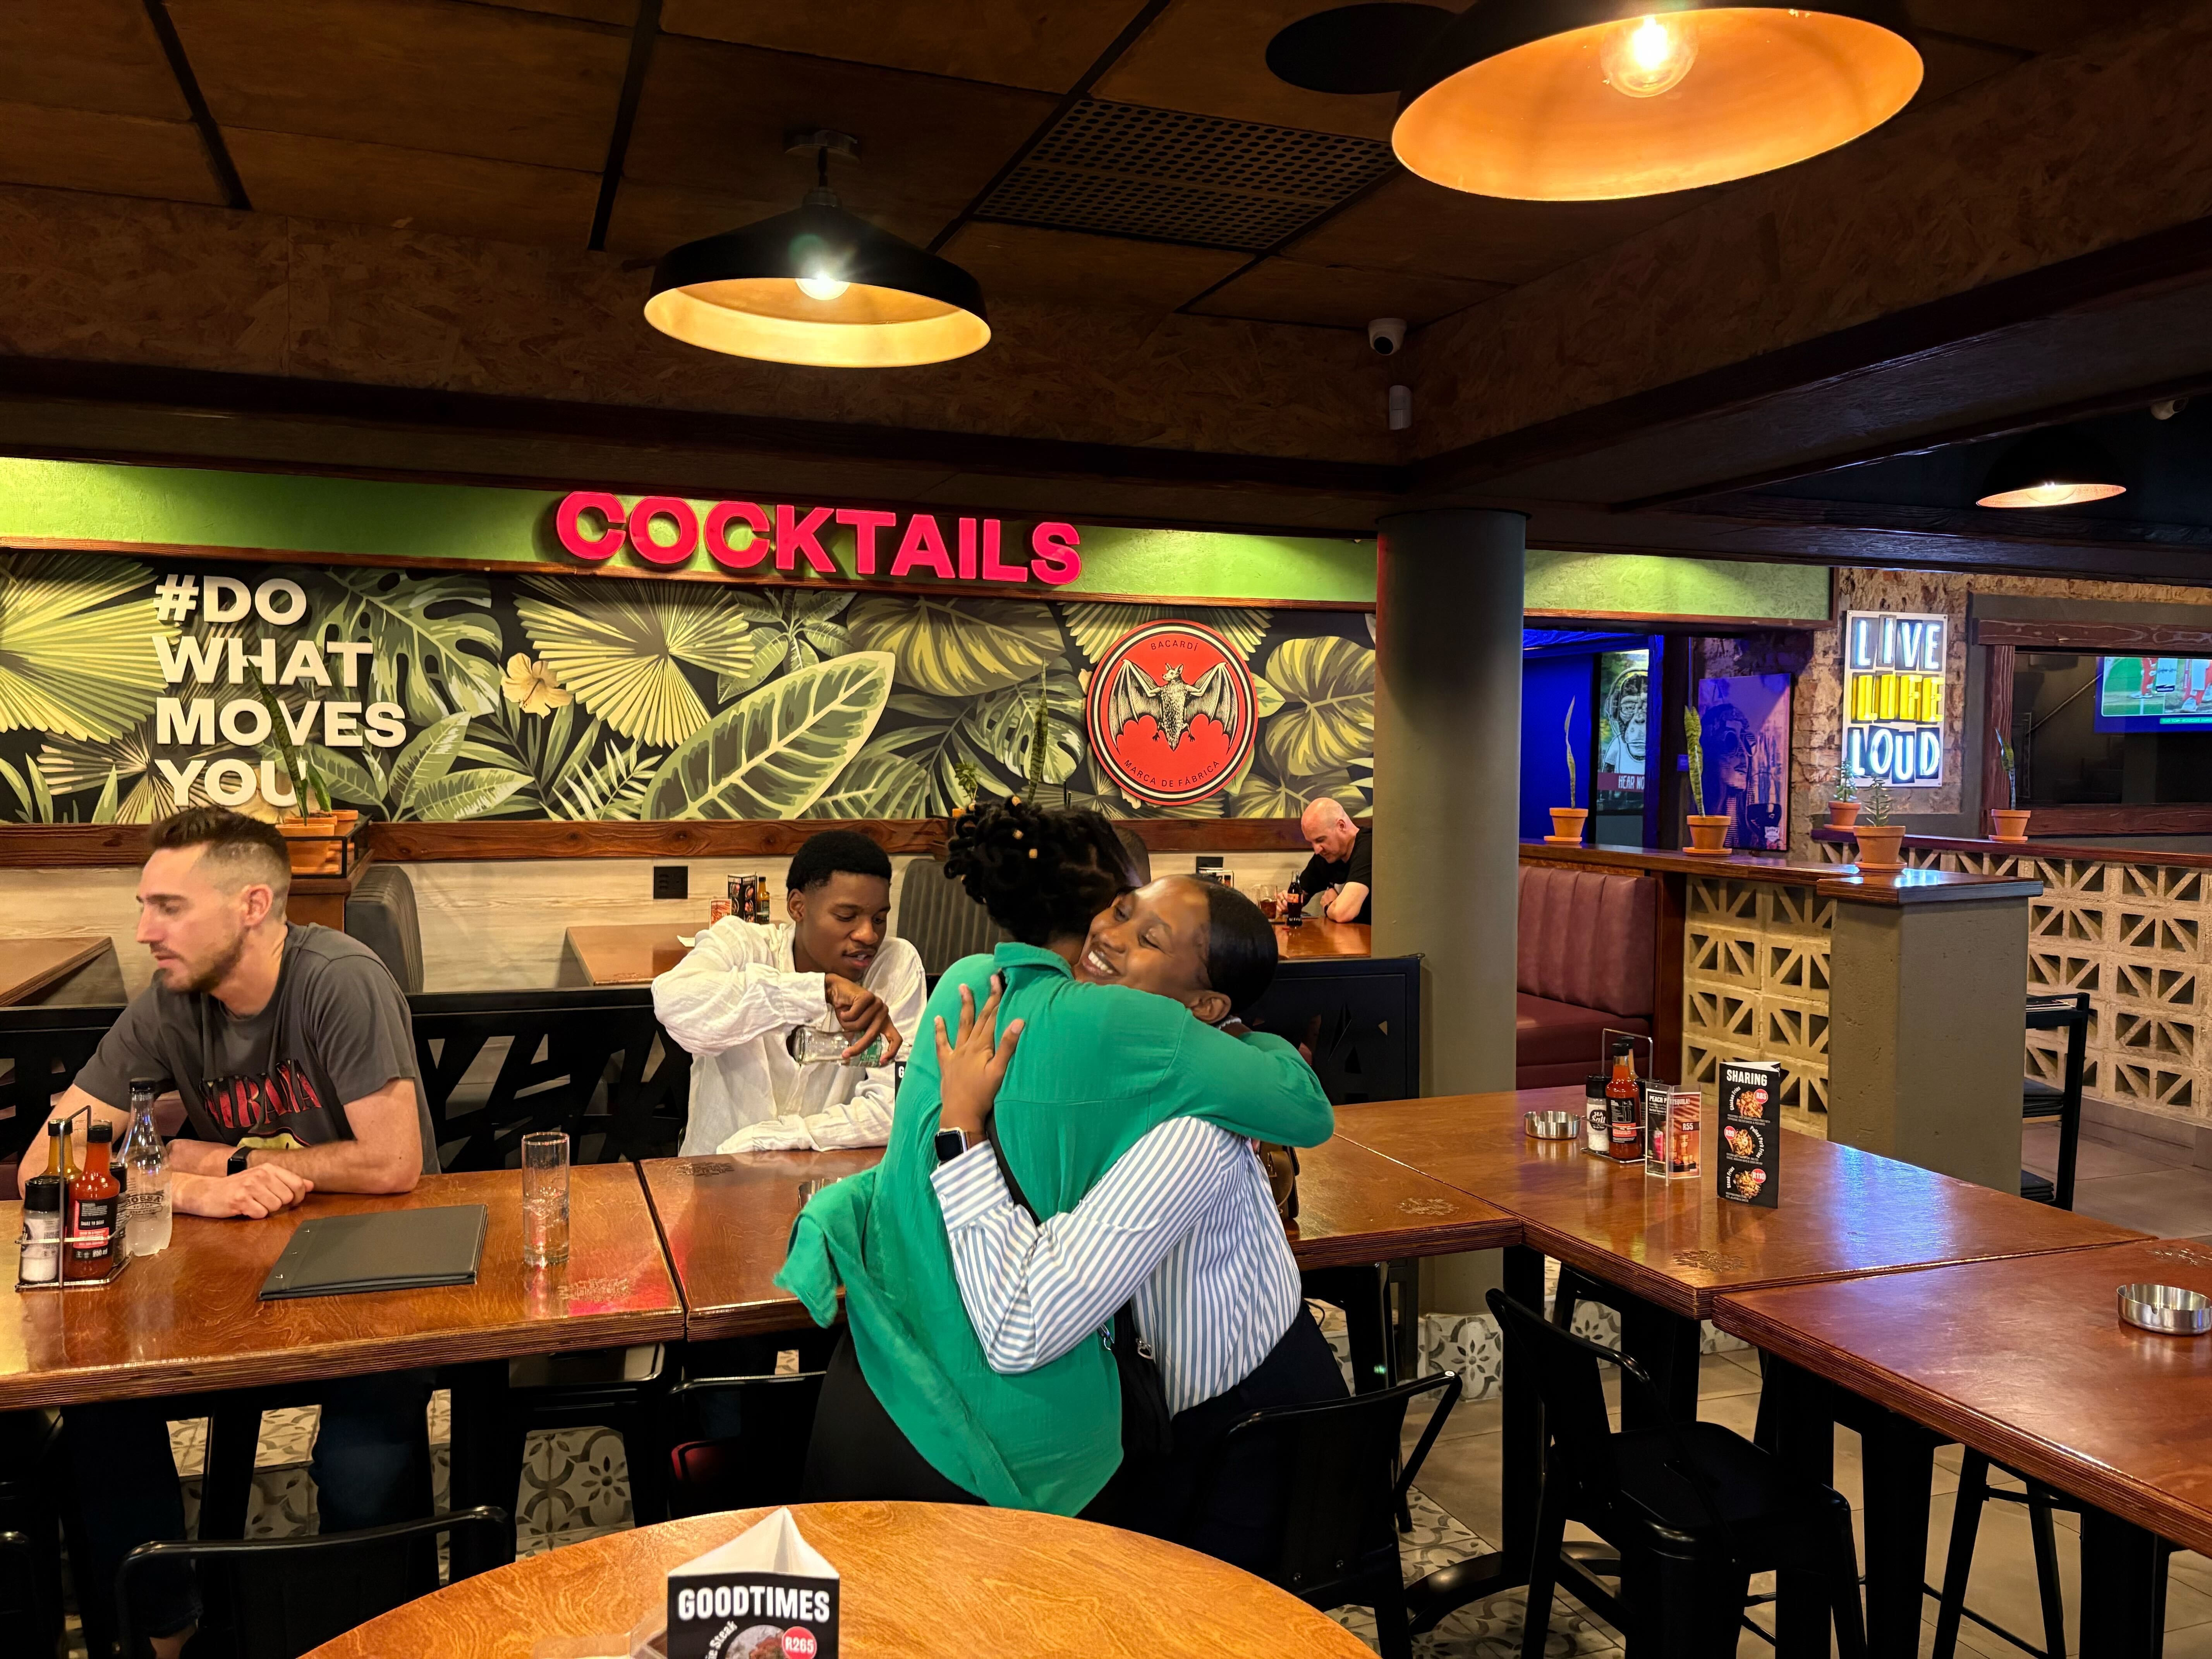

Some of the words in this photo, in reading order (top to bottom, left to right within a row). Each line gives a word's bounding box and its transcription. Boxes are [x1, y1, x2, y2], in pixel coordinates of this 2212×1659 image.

[556, 491, 1082, 586] COCKTAILS
[153, 574, 307, 625] #DO
[152, 636, 373, 687] WHAT
[1151, 640, 1199, 651] BACARDÍ
[1857, 618, 1941, 669] LIVE
[1857, 674, 1945, 722] LIFE
[156, 697, 406, 748] MOVES
[1851, 728, 1940, 780] LOUD
[155, 759, 307, 807] YOU
[1124, 759, 1156, 785] MARCA
[1162, 780, 1174, 788] DE
[1178, 760, 1219, 787] FÁBRICA
[1618, 775, 1635, 790] HEAR
[1637, 776, 1645, 790] NO
[1726, 1069, 1767, 1086] SHARING
[1649, 1095, 1663, 1103] PEACH
[1683, 1123, 1693, 1131] R55
[678, 1585, 830, 1623] GOODTIMES
[709, 1621, 738, 1650] Steak
[785, 1636, 814, 1654] R265
